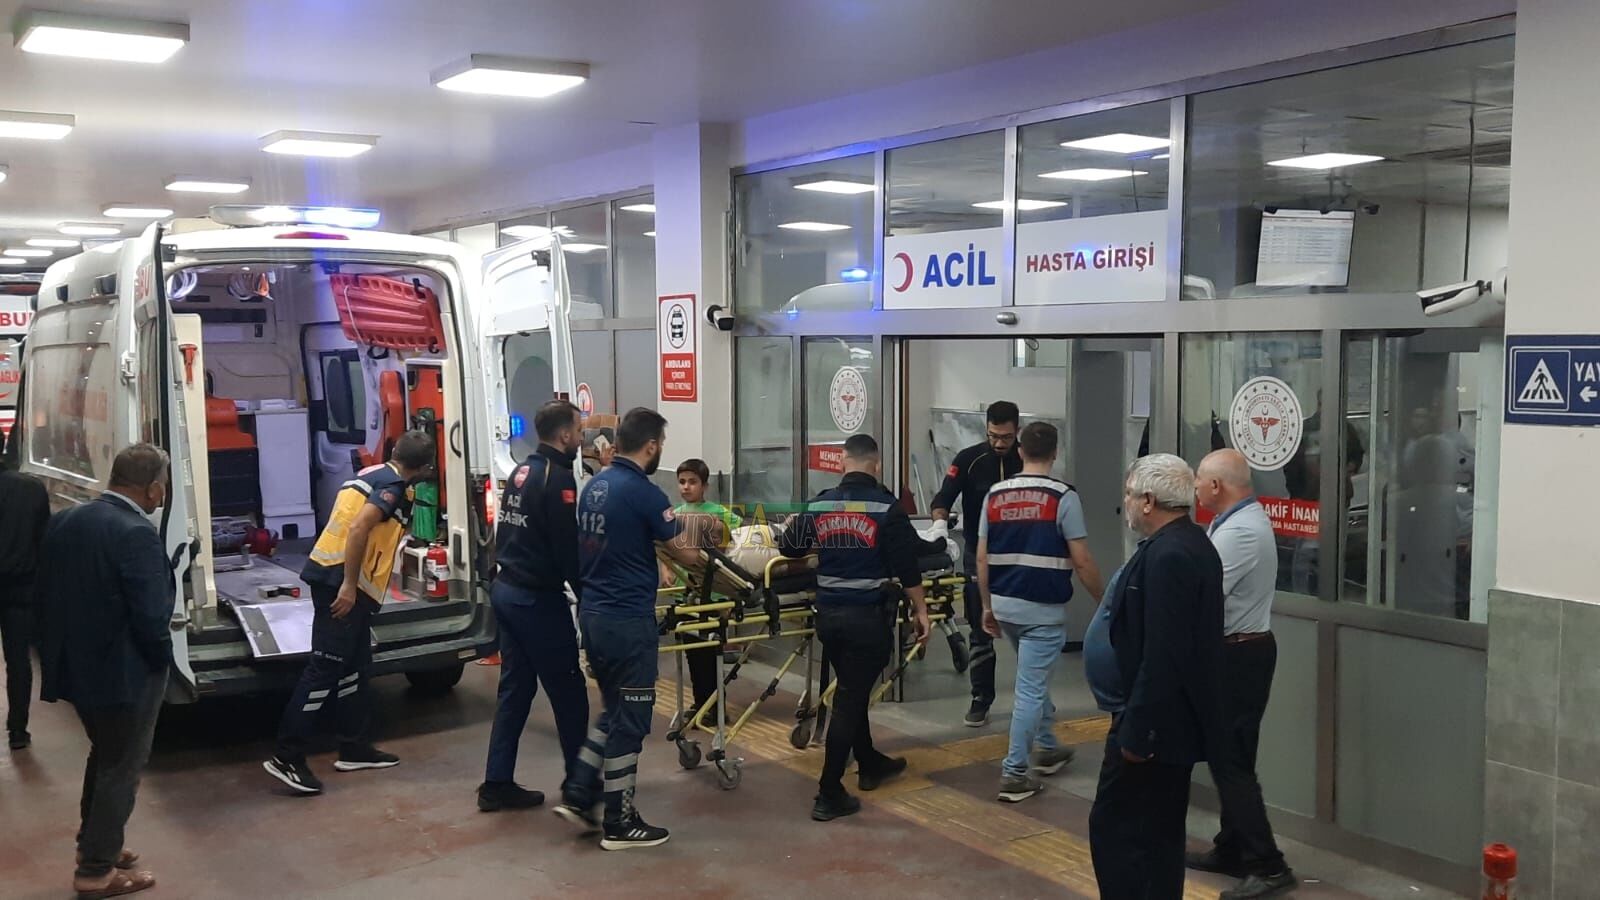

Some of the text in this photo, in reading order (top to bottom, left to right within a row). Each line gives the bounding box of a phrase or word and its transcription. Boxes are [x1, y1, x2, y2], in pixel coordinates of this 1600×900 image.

[922, 242, 996, 288] ACİL
[1026, 241, 1155, 273] HASTA GİRİŞİ
[581, 511, 605, 534] 112
[1264, 501, 1320, 522] AKİF İNAN
